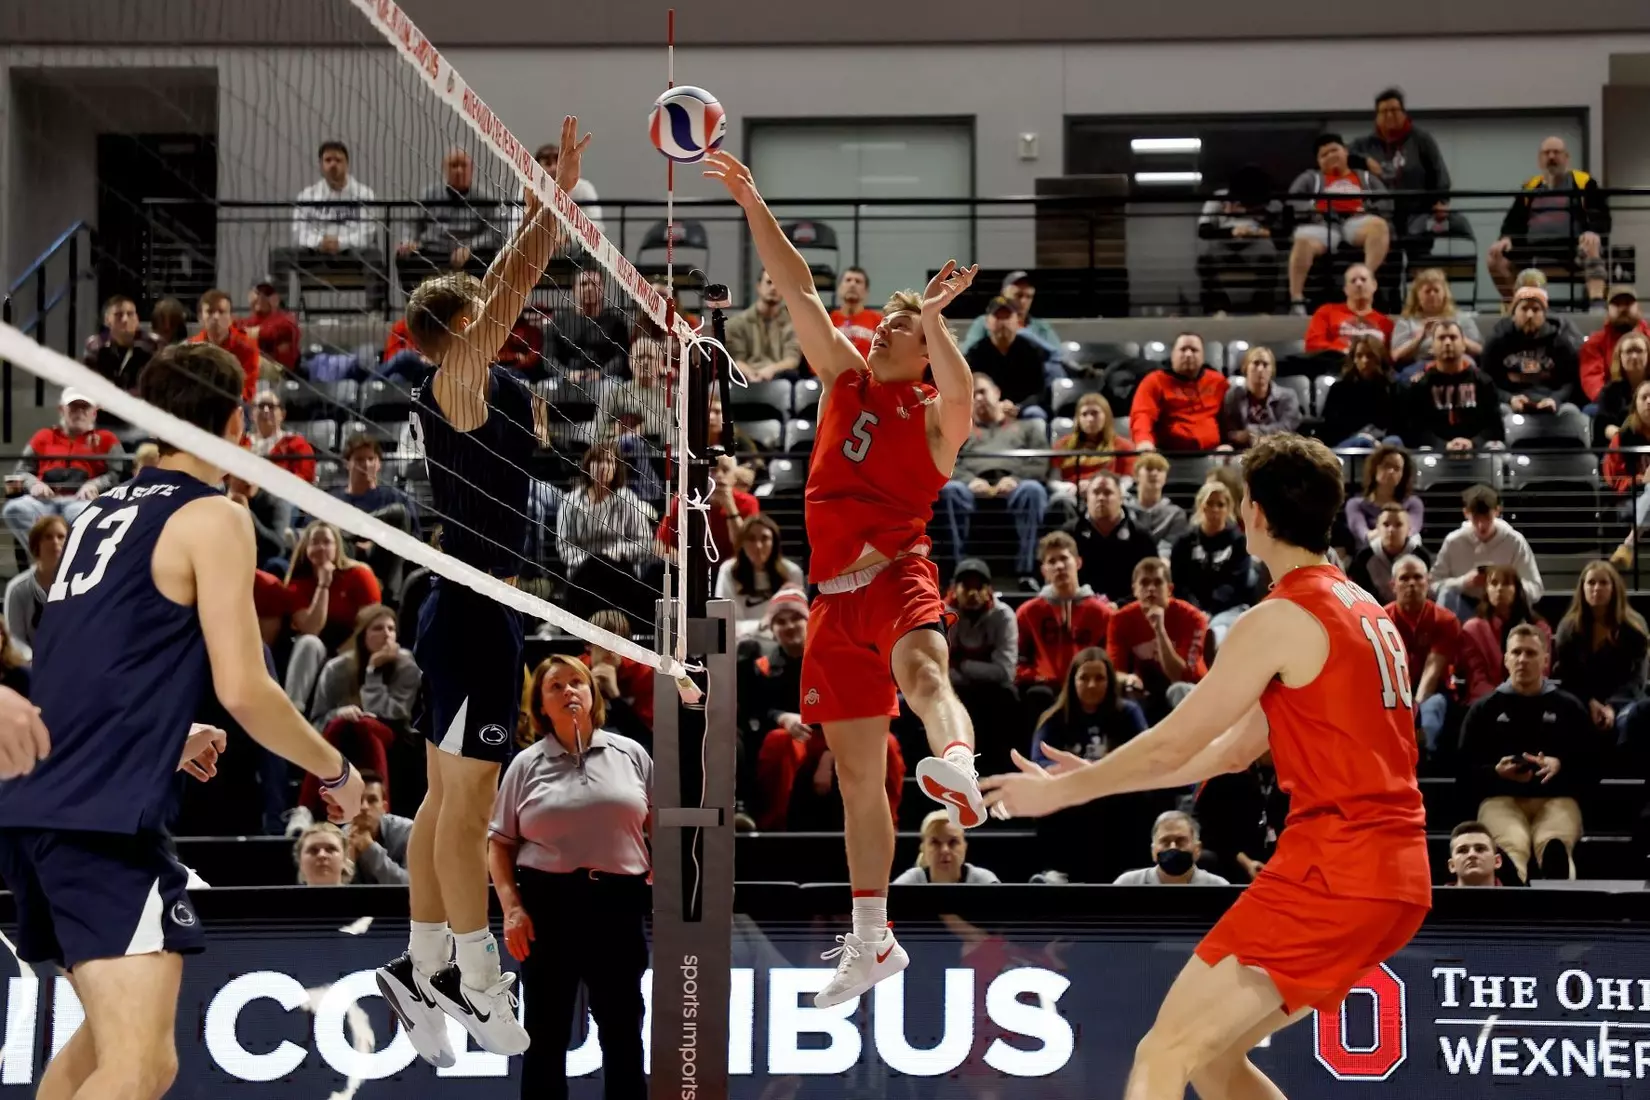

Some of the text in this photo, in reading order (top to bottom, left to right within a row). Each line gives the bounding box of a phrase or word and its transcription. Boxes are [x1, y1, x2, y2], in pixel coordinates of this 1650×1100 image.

[842, 410, 879, 464] 5
[47, 505, 139, 602] 13
[1360, 615, 1412, 709] 18
[679, 954, 700, 1018] sports
